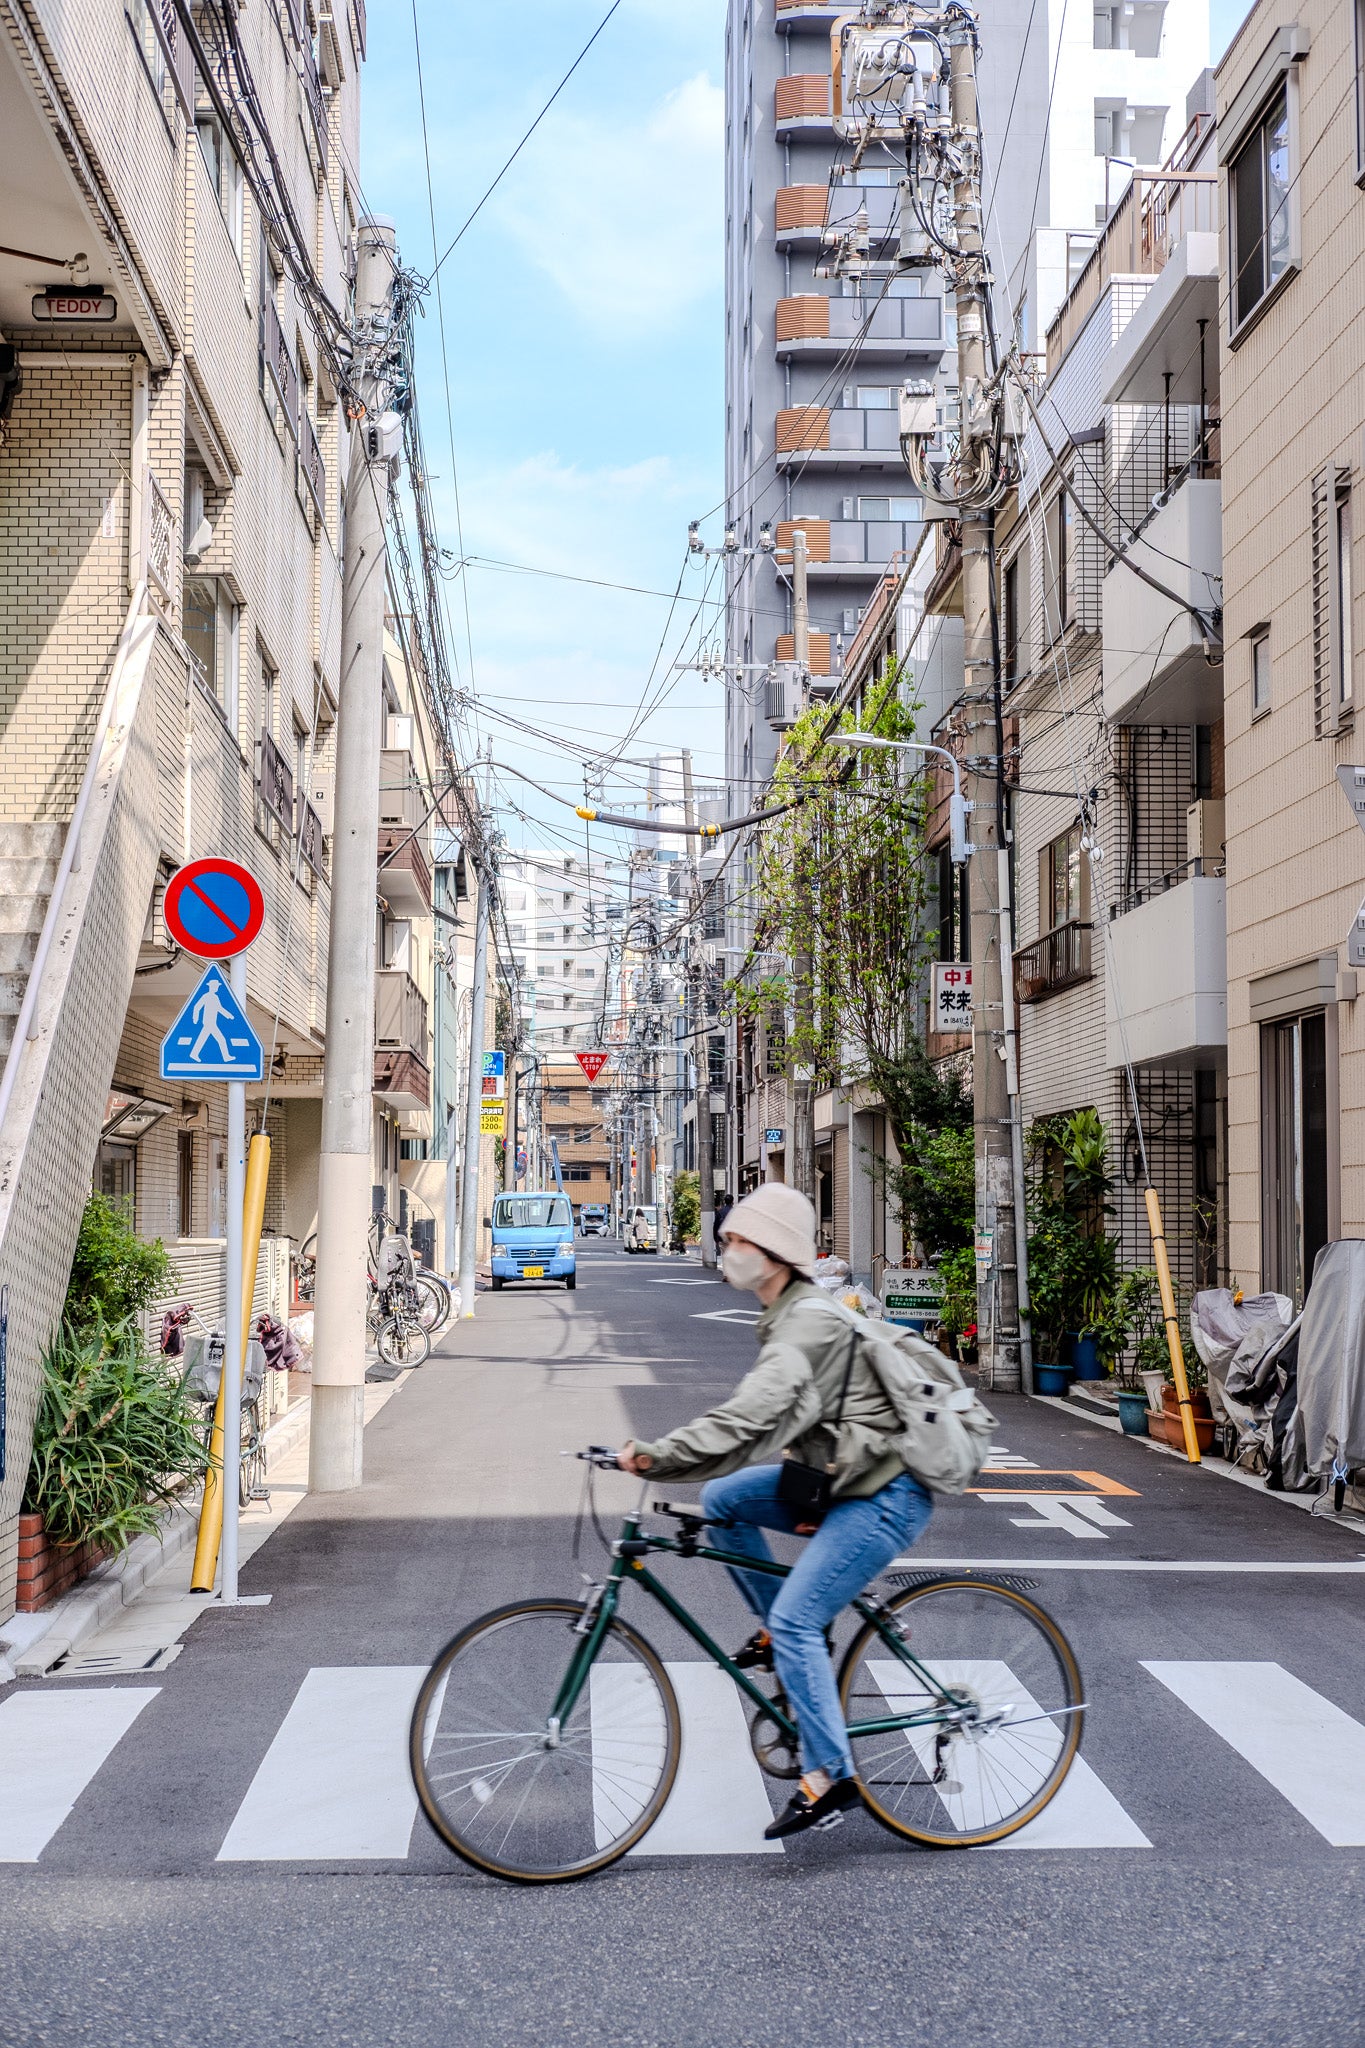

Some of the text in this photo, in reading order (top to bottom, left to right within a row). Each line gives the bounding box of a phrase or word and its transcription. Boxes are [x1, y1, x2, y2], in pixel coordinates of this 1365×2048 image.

[46, 299, 102, 314] TEDDY
[582, 1056, 602, 1064] 止まれ
[766, 1129, 781, 1142] 空
